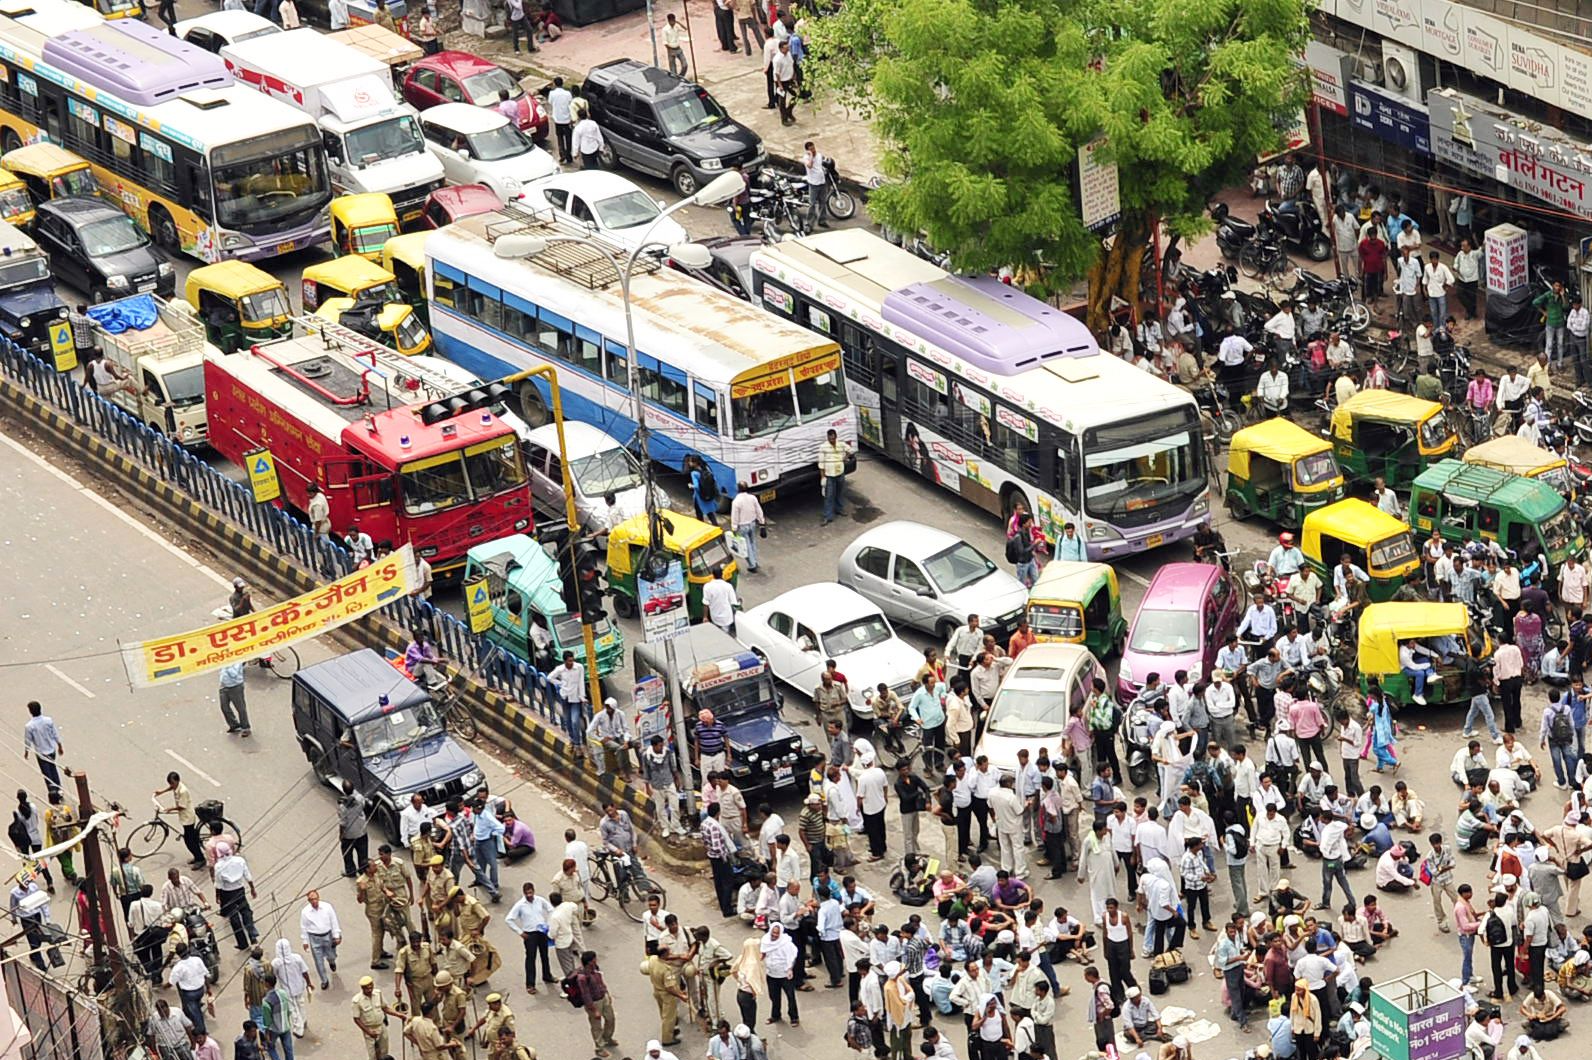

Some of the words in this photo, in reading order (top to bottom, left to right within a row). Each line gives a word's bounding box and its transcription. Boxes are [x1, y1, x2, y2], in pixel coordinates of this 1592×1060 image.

[1512, 42, 1526, 55] DENA
[1511, 52, 1550, 79] SUVIDHA
[1525, 180, 1540, 195] ISO
[701, 675, 733, 689] LUCKNOW
[737, 667, 760, 679] POLICE
[1372, 1006, 1394, 1029] India's
[1410, 1016, 1434, 1035] भारत
[1435, 1011, 1449, 1027] का
[1372, 1020, 1400, 1044] Network
[1431, 1023, 1462, 1044] नेटवर्क
